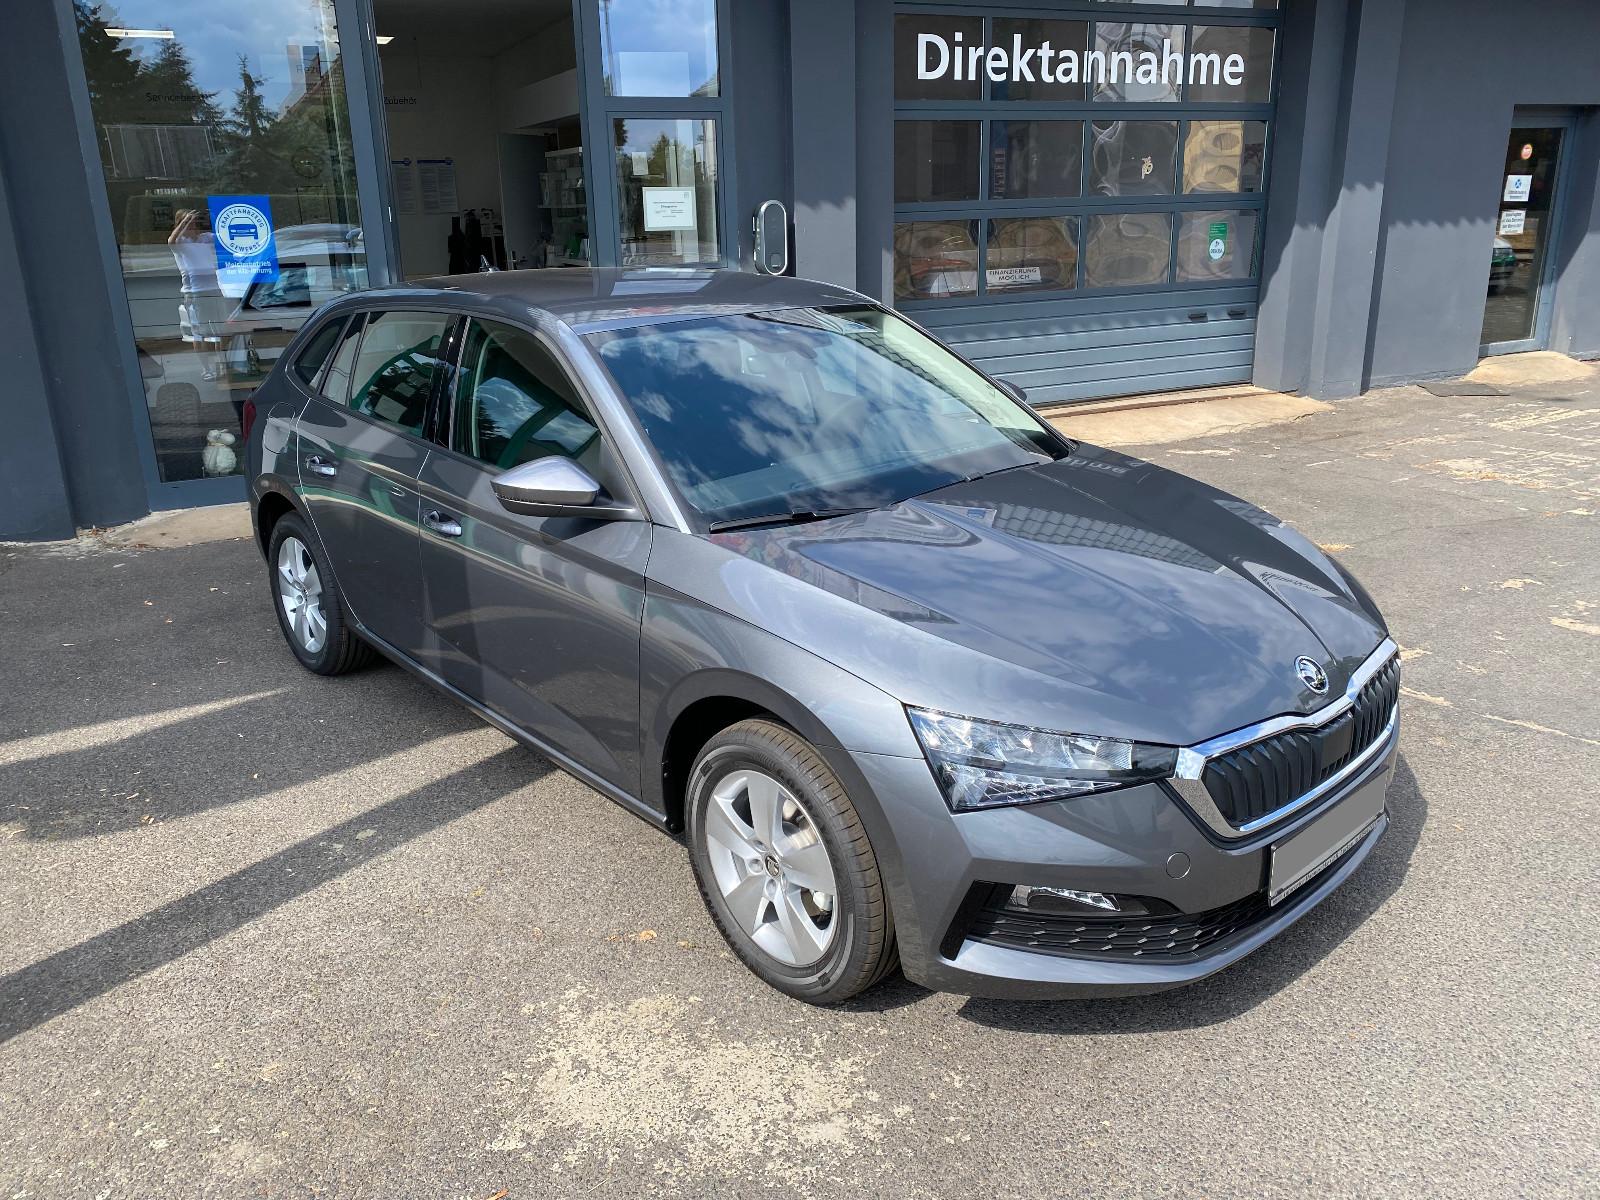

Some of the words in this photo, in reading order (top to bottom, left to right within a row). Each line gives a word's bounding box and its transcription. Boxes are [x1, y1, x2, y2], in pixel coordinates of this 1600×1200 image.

[916, 31, 1246, 86] Direktannahme
[220, 208, 265, 229] KRAFTFAHRZEUG
[989, 268, 1037, 276] FINANZIERUNG
